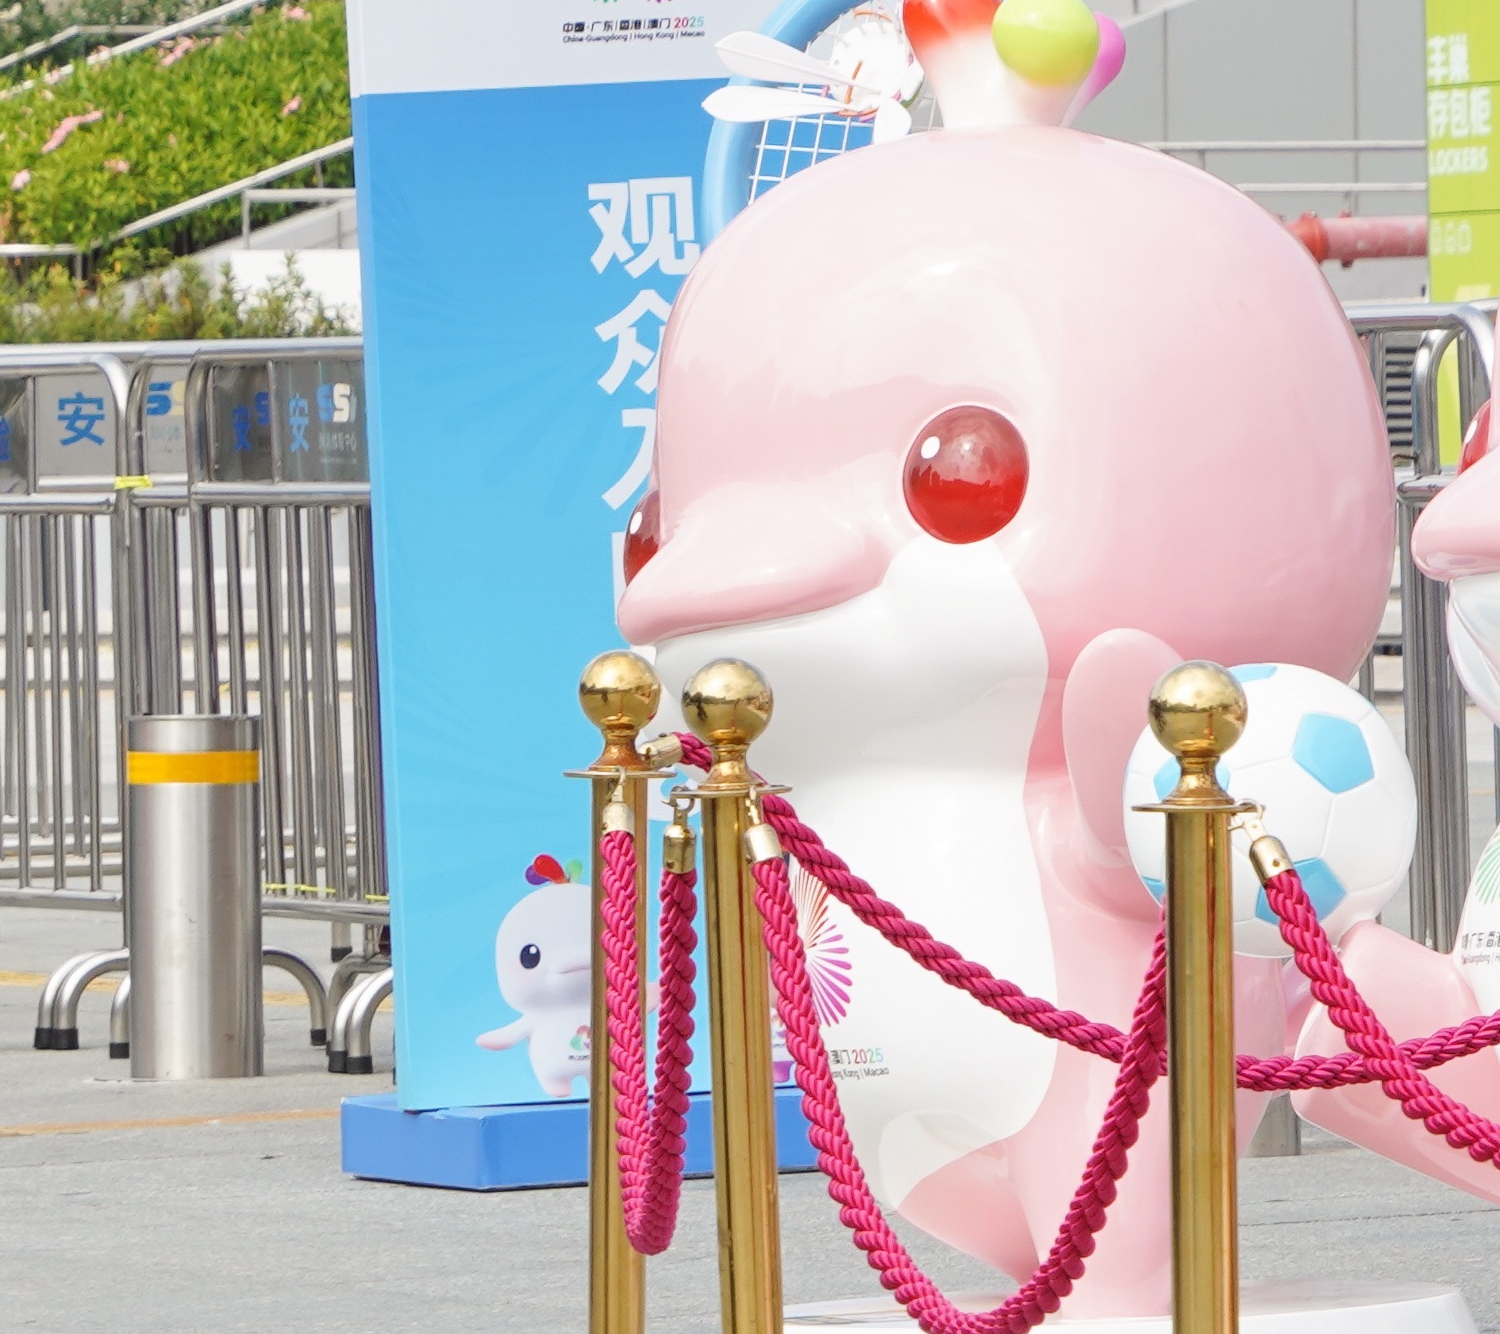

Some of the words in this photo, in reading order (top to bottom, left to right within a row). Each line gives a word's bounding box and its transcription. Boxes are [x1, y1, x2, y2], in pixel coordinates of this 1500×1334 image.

[674, 16, 705, 28] 2025
[1428, 146, 1489, 176] LOCKERS
[57, 391, 106, 447] 安
[288, 393, 309, 453] 安
[851, 1047, 885, 1064] 2025
